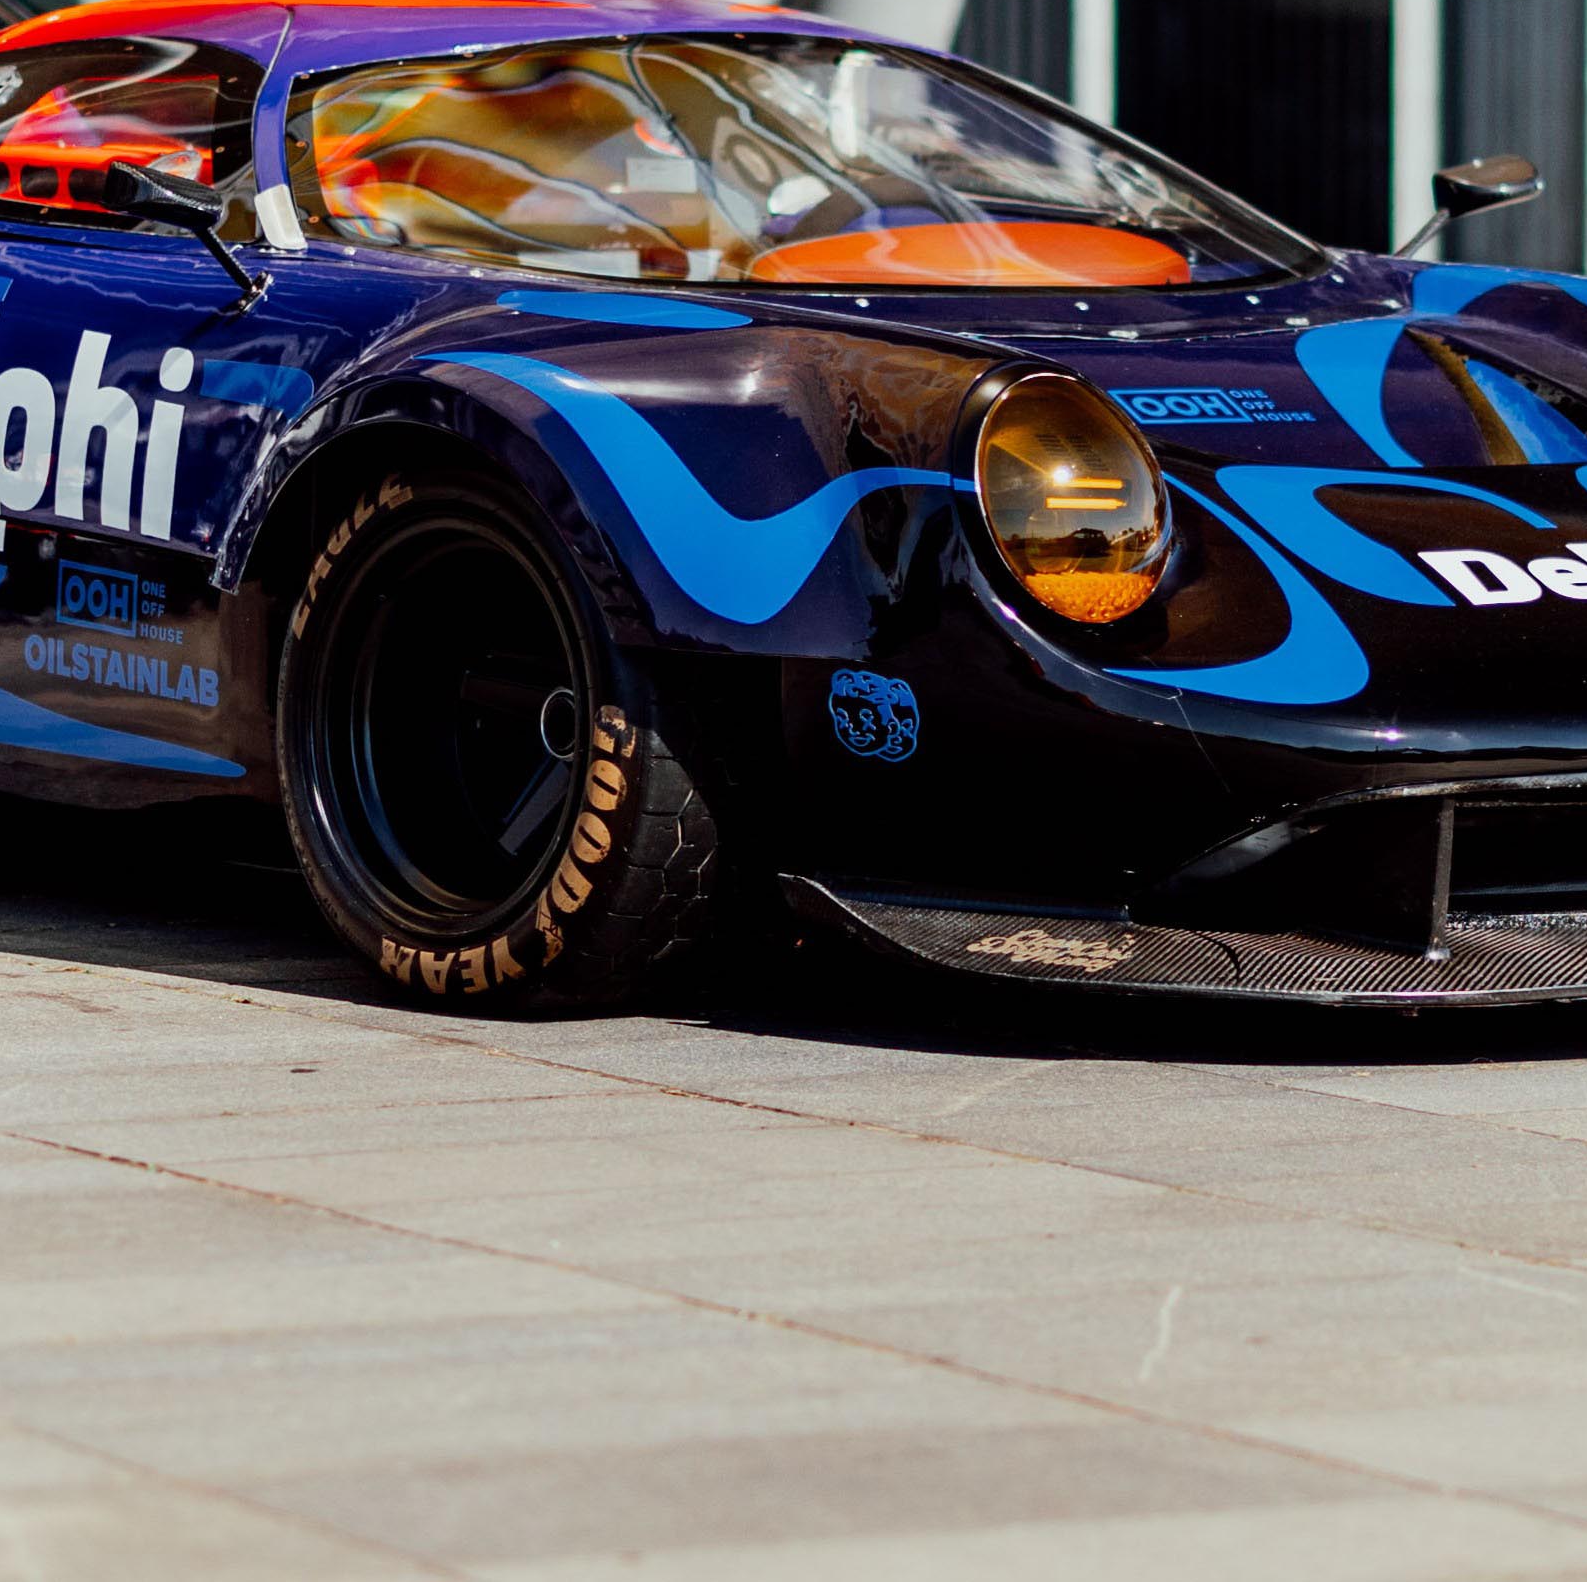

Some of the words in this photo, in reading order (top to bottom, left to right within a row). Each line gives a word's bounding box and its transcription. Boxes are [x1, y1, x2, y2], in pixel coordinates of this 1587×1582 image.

[1228, 390, 1269, 399] ONE
[1131, 395, 1234, 417] OOH
[1241, 401, 1276, 411] OFF
[1252, 412, 1317, 422] HOUSE
[65, 575, 129, 622] OOH
[141, 580, 166, 599] ONE
[141, 600, 165, 618] OFF
[140, 623, 184, 645] HOUSE
[24, 634, 220, 707] OILSTAINLAB
[381, 934, 526, 995] YEAR
